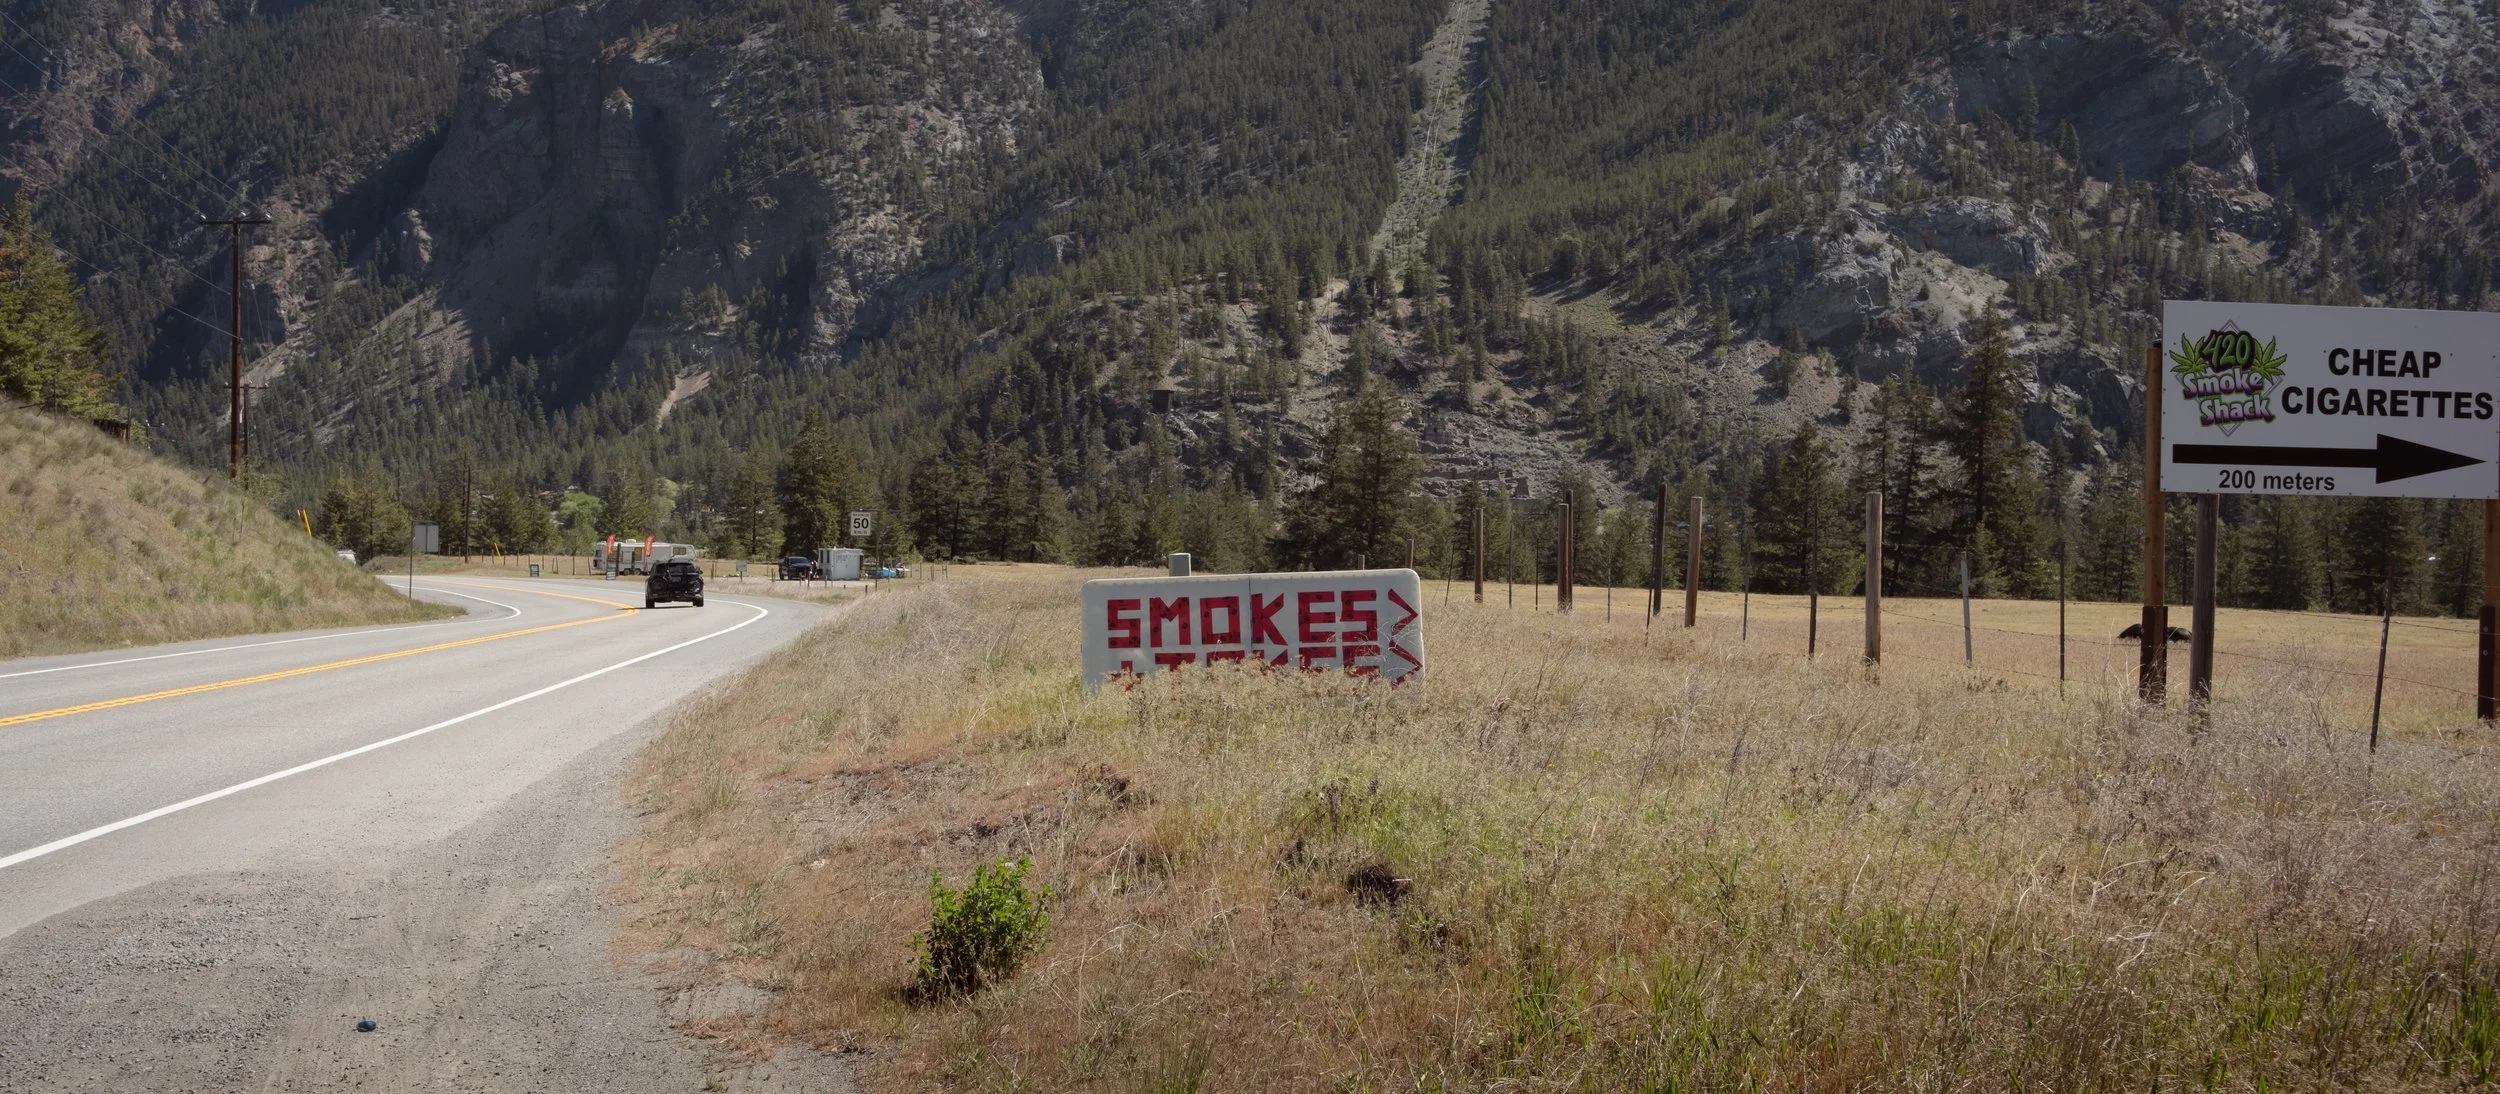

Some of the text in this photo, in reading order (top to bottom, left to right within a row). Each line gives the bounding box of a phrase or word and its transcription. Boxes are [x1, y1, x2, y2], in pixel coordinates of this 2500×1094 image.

[2202, 331, 2253, 370] 420
[2327, 347, 2442, 379] CHEAP
[2182, 366, 2264, 399] Smoke
[2200, 394, 2275, 426] Shack
[2280, 386, 2494, 420] CIGARETTES
[2218, 469, 2336, 491] 200 meters
[853, 518, 869, 529] 50
[1107, 589, 1379, 649] SMOKES
[1154, 645, 1382, 682] TES
